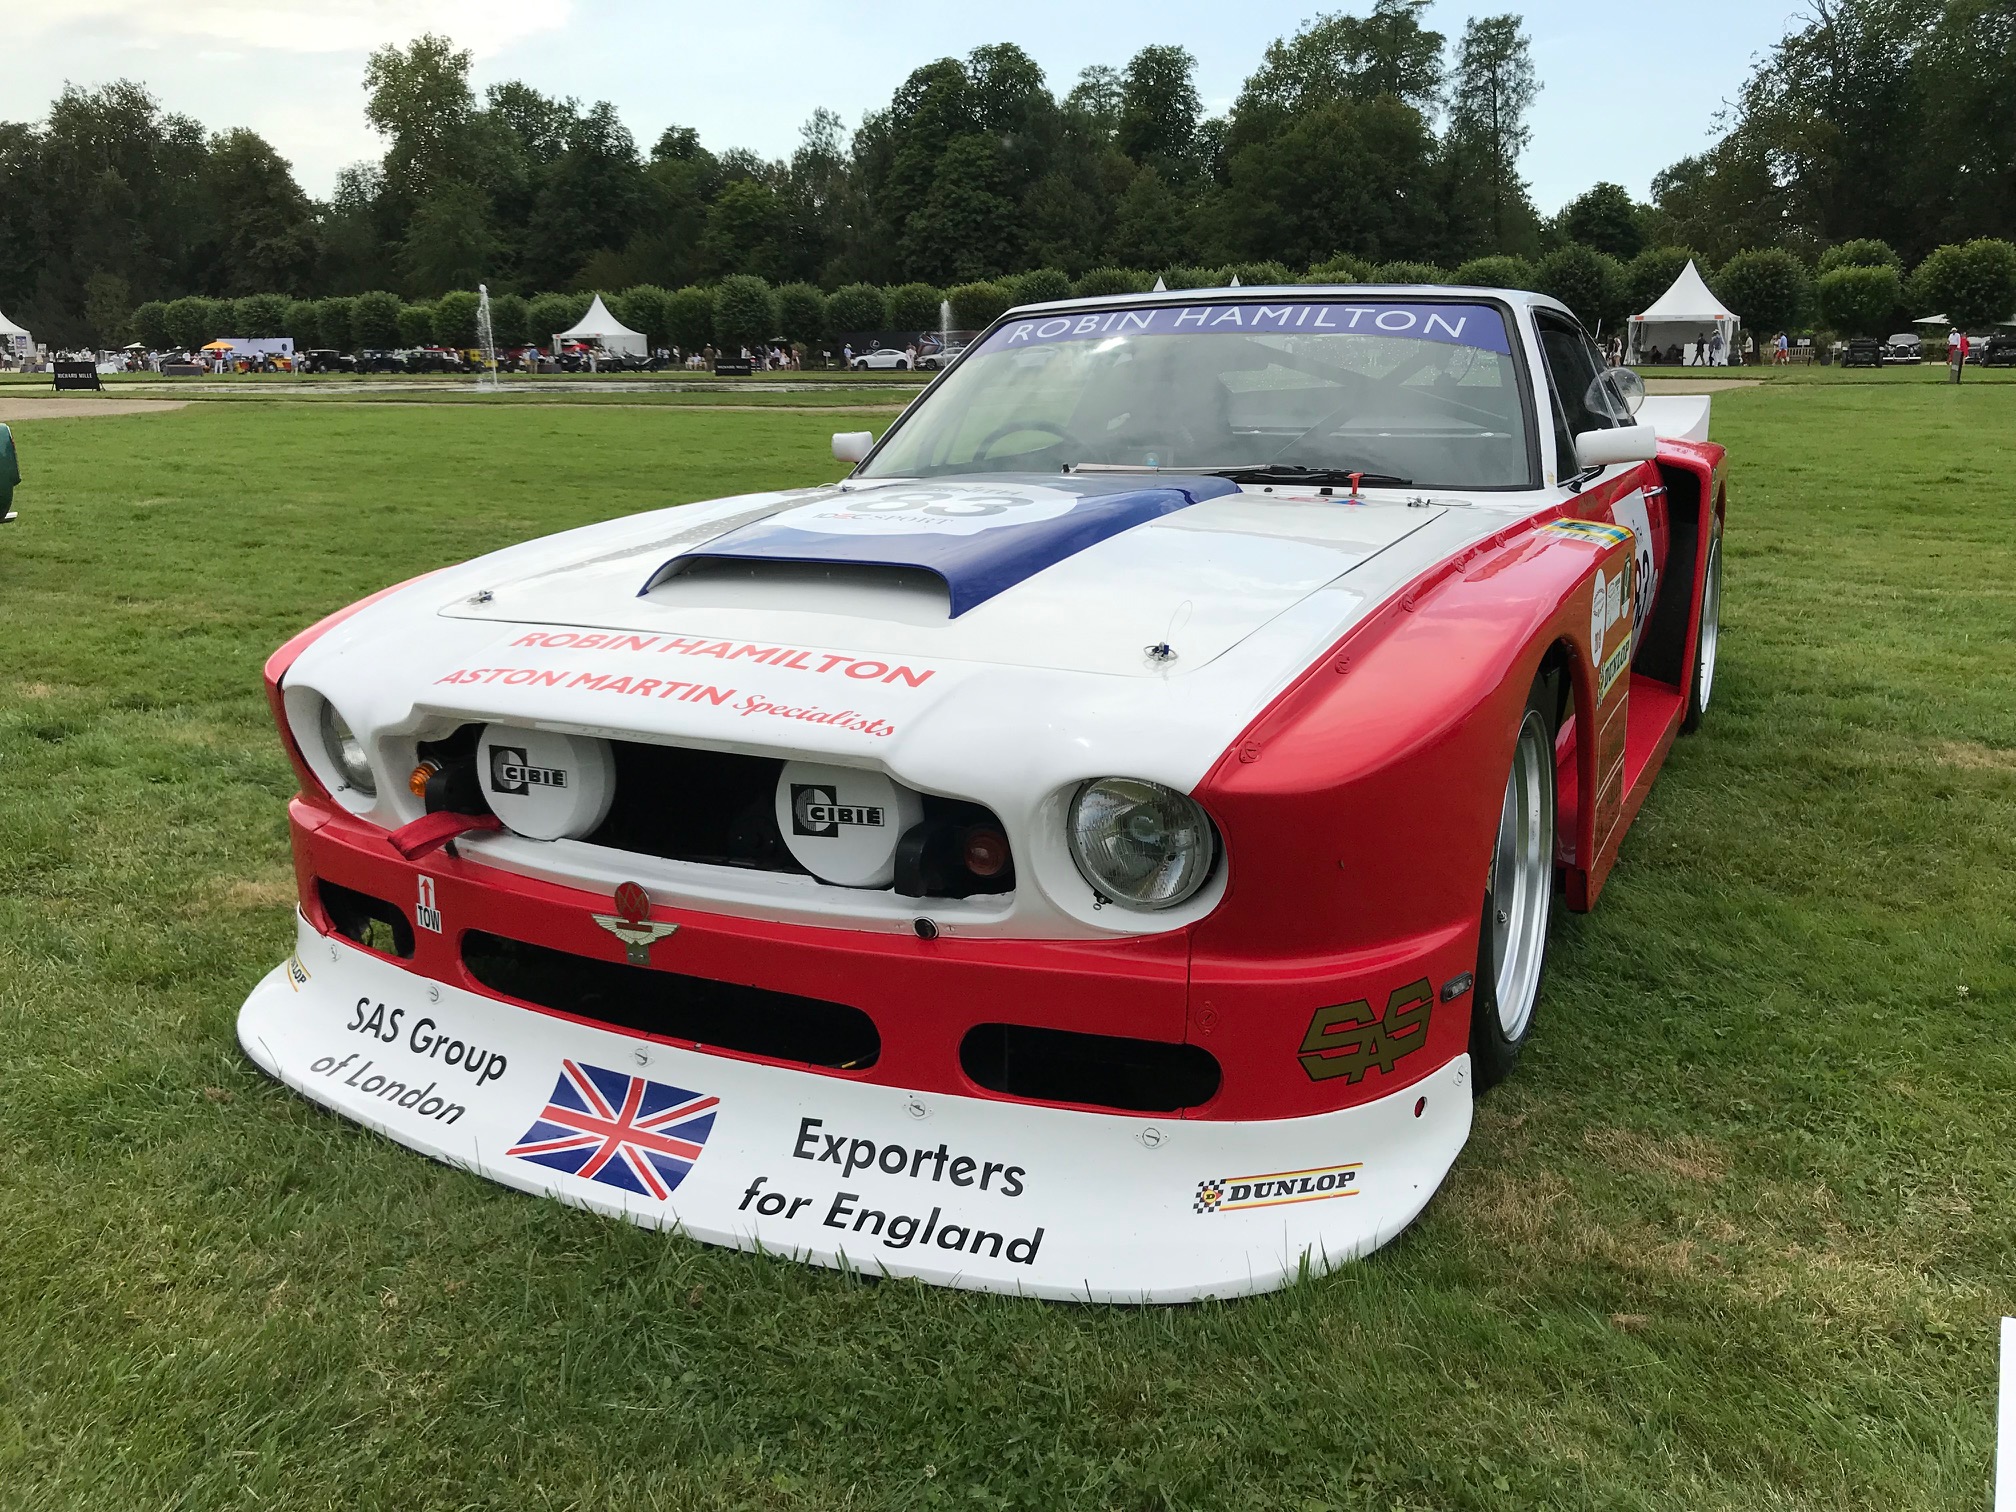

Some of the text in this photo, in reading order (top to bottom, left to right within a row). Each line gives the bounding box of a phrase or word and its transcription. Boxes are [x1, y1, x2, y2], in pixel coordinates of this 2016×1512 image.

[1008, 306, 1467, 344] ROBIN HAMILTON
[845, 492, 1035, 517] 83
[508, 632, 936, 688] ROBIN HAMILTON
[432, 668, 896, 738] ASTON MARTIN Specialists
[418, 905, 440, 932] TOW
[347, 997, 507, 1086] SAS Group
[1297, 976, 1433, 1085] SAS
[310, 1053, 466, 1125] of London
[793, 1117, 1026, 1197] Exporters
[1227, 1171, 1355, 1202] DUNLOP
[737, 1176, 1045, 1265] for England
